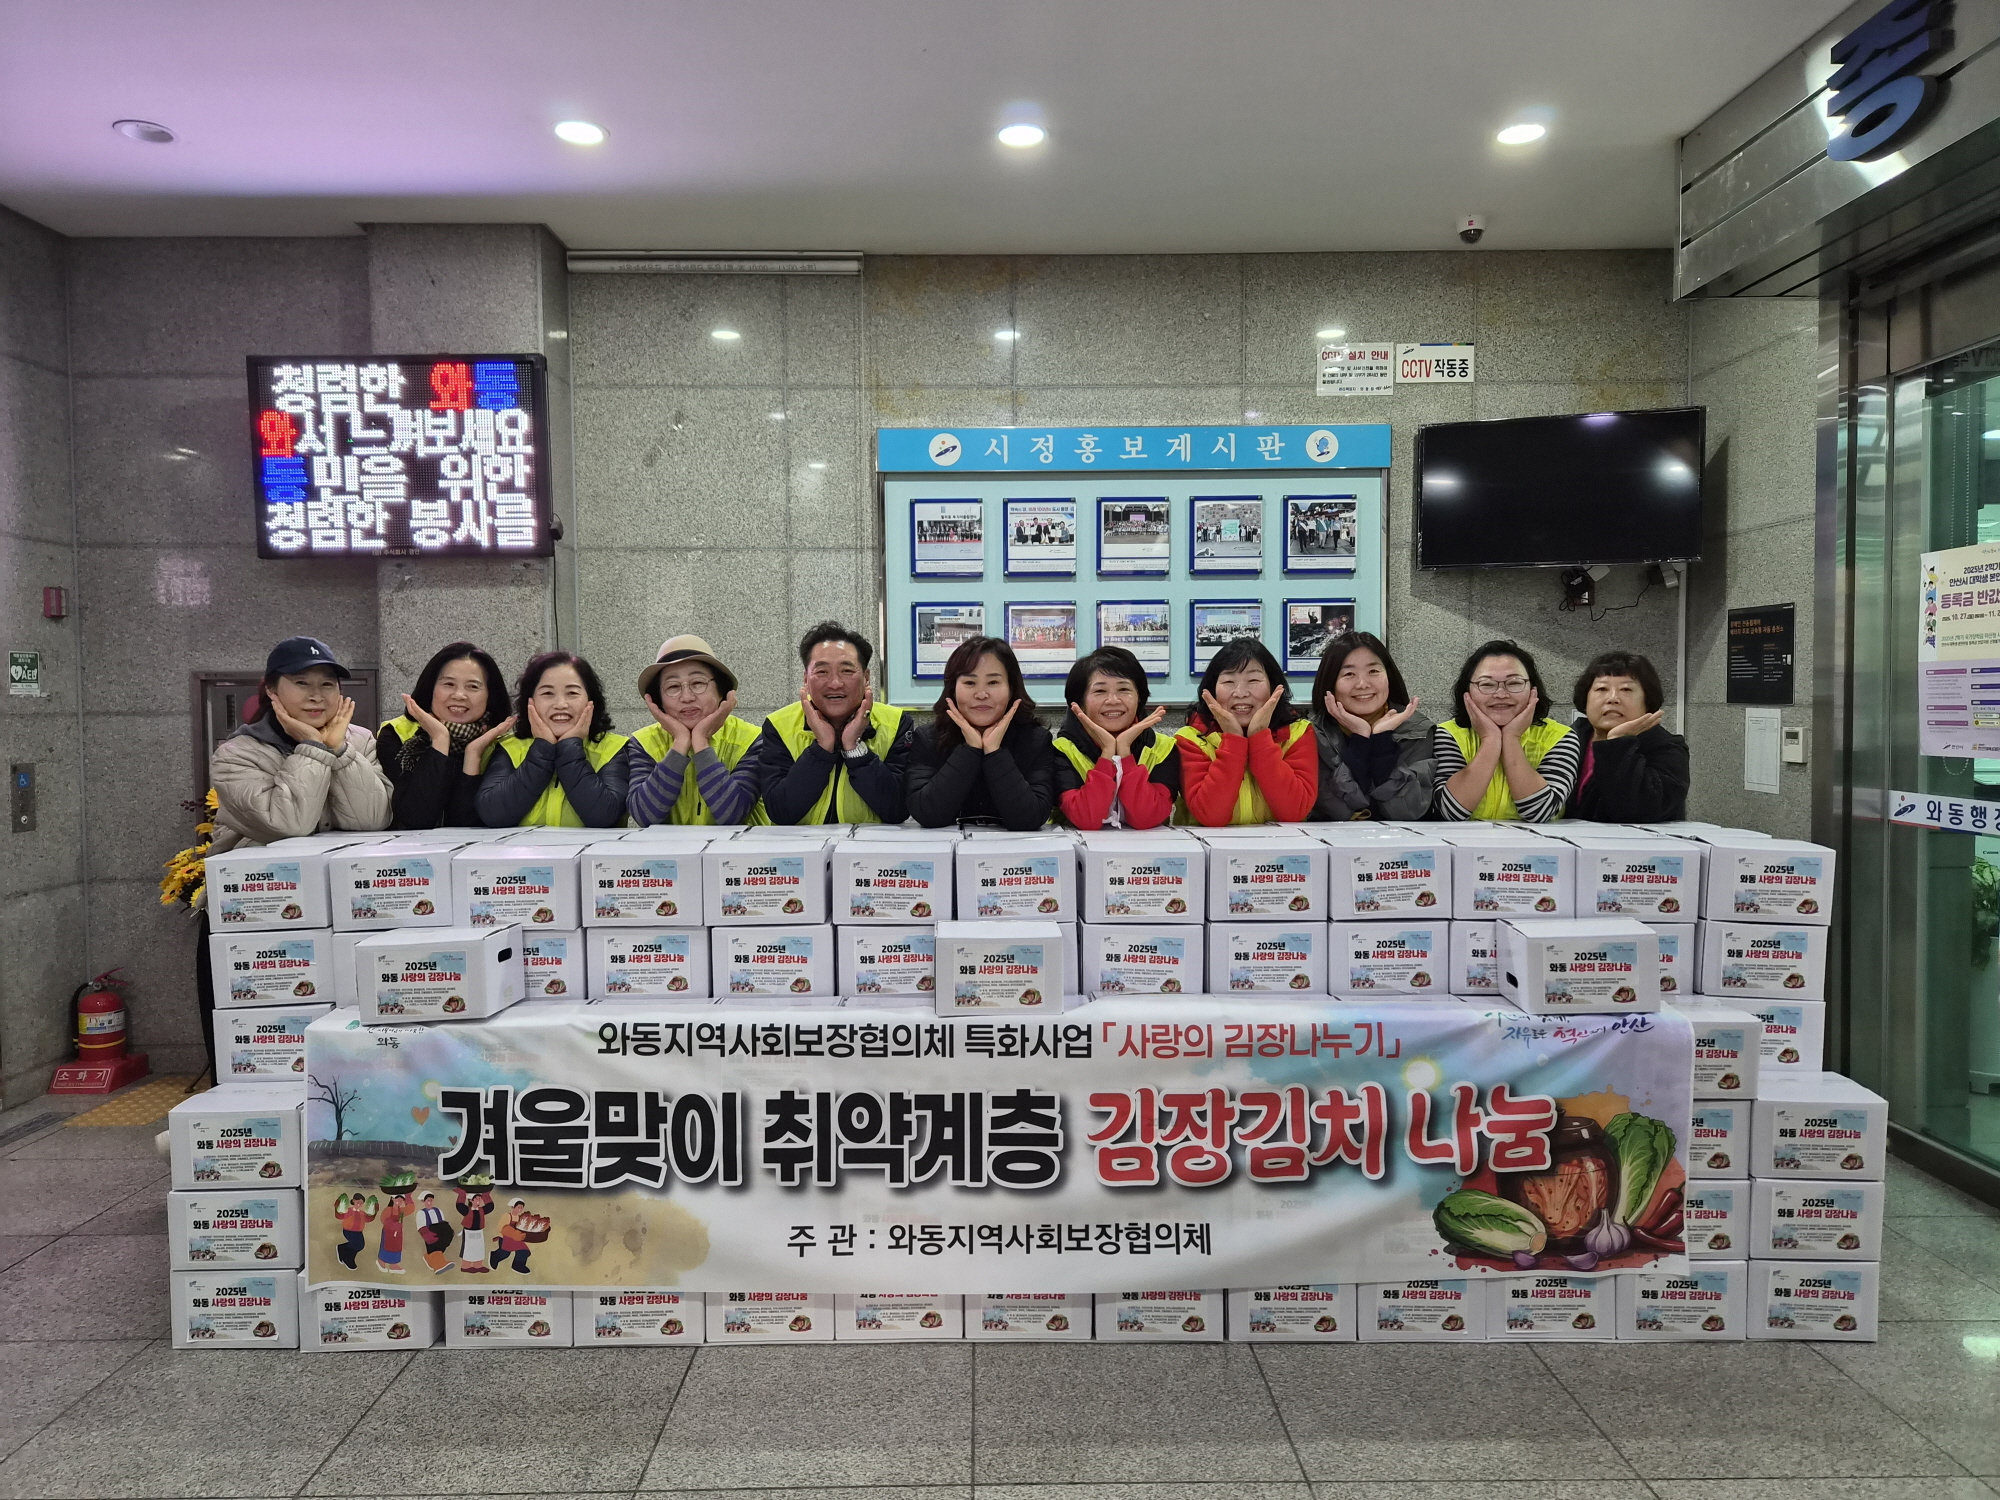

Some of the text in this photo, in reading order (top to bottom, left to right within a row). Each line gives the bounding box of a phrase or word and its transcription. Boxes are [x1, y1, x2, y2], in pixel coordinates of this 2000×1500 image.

[1348, 351, 1366, 361] 설치
[1371, 351, 1389, 360] 안내
[1401, 358, 1470, 378] CCTV 작동중
[1964, 564, 1984, 574] 2025년
[1949, 576, 1968, 587] 안산시
[1940, 590, 1974, 609] 등록금
[1131, 865, 1160, 874] 2025년
[1379, 861, 1408, 870] 2025년
[1501, 862, 1530, 872] 2025년
[1763, 864, 1793, 874] 2025년
[377, 868, 407, 877] 2025년
[621, 869, 650, 877] 2025년
[1003, 867, 1032, 875] 2025년
[1358, 868, 1430, 881] 와동 사랑의 김장나눔
[246, 873, 274, 881] 2025년
[981, 876, 1054, 886] 와동 사랑의 김장나눔
[1110, 876, 1182, 885] 와동 사랑의 김장나눔
[1479, 873, 1554, 883] 와동 사랑의 김장나눔
[1740, 875, 1816, 884] 와동 사랑의 김장나눔
[224, 882, 296, 892] 와동 사랑의 김장나눔
[355, 878, 429, 888] 와동 사랑의 김장나눔
[599, 879, 672, 888] 와동 사랑의 김장나눔
[856, 879, 928, 888] 와동 사랑의 김장나눔
[756, 945, 785, 953] 2025년
[1128, 945, 1157, 953] 2025년
[1377, 940, 1405, 948] 2025년
[1750, 940, 1779, 948] 2025년
[257, 948, 286, 958] 2025년
[1355, 950, 1427, 959] 와동 사랑의 김장나눔
[1575, 952, 1606, 961] 2025년
[1728, 949, 1802, 959] 와동 사랑의 김장나눔
[735, 955, 807, 963] 와동 사랑의 김장나눔
[983, 954, 1014, 963] 2025년
[1106, 954, 1179, 964] 와동 사랑의 김장나눔
[234, 959, 309, 970] 와동 사랑의 김장나눔
[405, 962, 437, 970] 2025년
[960, 965, 1037, 974] 와동 사랑의 김장나눔
[1550, 963, 1631, 972] 와동 사랑의 김장나눔
[382, 972, 461, 982] 와동 사랑의 김장나눔
[1612, 1016, 1655, 1034] 안산
[376, 1036, 401, 1050] 와동
[598, 1022, 1400, 1059] 와동지역사회보장협의체 특화사업 「사랑의 김장나누기」
[58, 1070, 107, 1082] 소화기
[1804, 1117, 1837, 1127] 2025년
[221, 1128, 252, 1137] 2025년
[440, 1084, 1555, 1185] 겨울맞이 취약계층 김장김치 나눔
[1780, 1129, 1861, 1138] 와동 사랑의 김장나눔
[197, 1138, 276, 1149] 와동 사랑의 김장나눔
[1802, 1197, 1834, 1207] 2025년
[1778, 1209, 1857, 1218] 와동 사랑의 김장나눔
[887, 1222, 1212, 1256] 와동지역사회보장협의체
[1407, 1278, 1438, 1289] 2025년
[1798, 1277, 1830, 1288] 2025년
[216, 1287, 247, 1296] 2025년
[1383, 1290, 1461, 1300] 와동 사랑의 김장나눔
[1775, 1288, 1854, 1300] 와동 사랑의 김장나눔
[193, 1298, 270, 1307] 와동 사랑의 김장나눔
